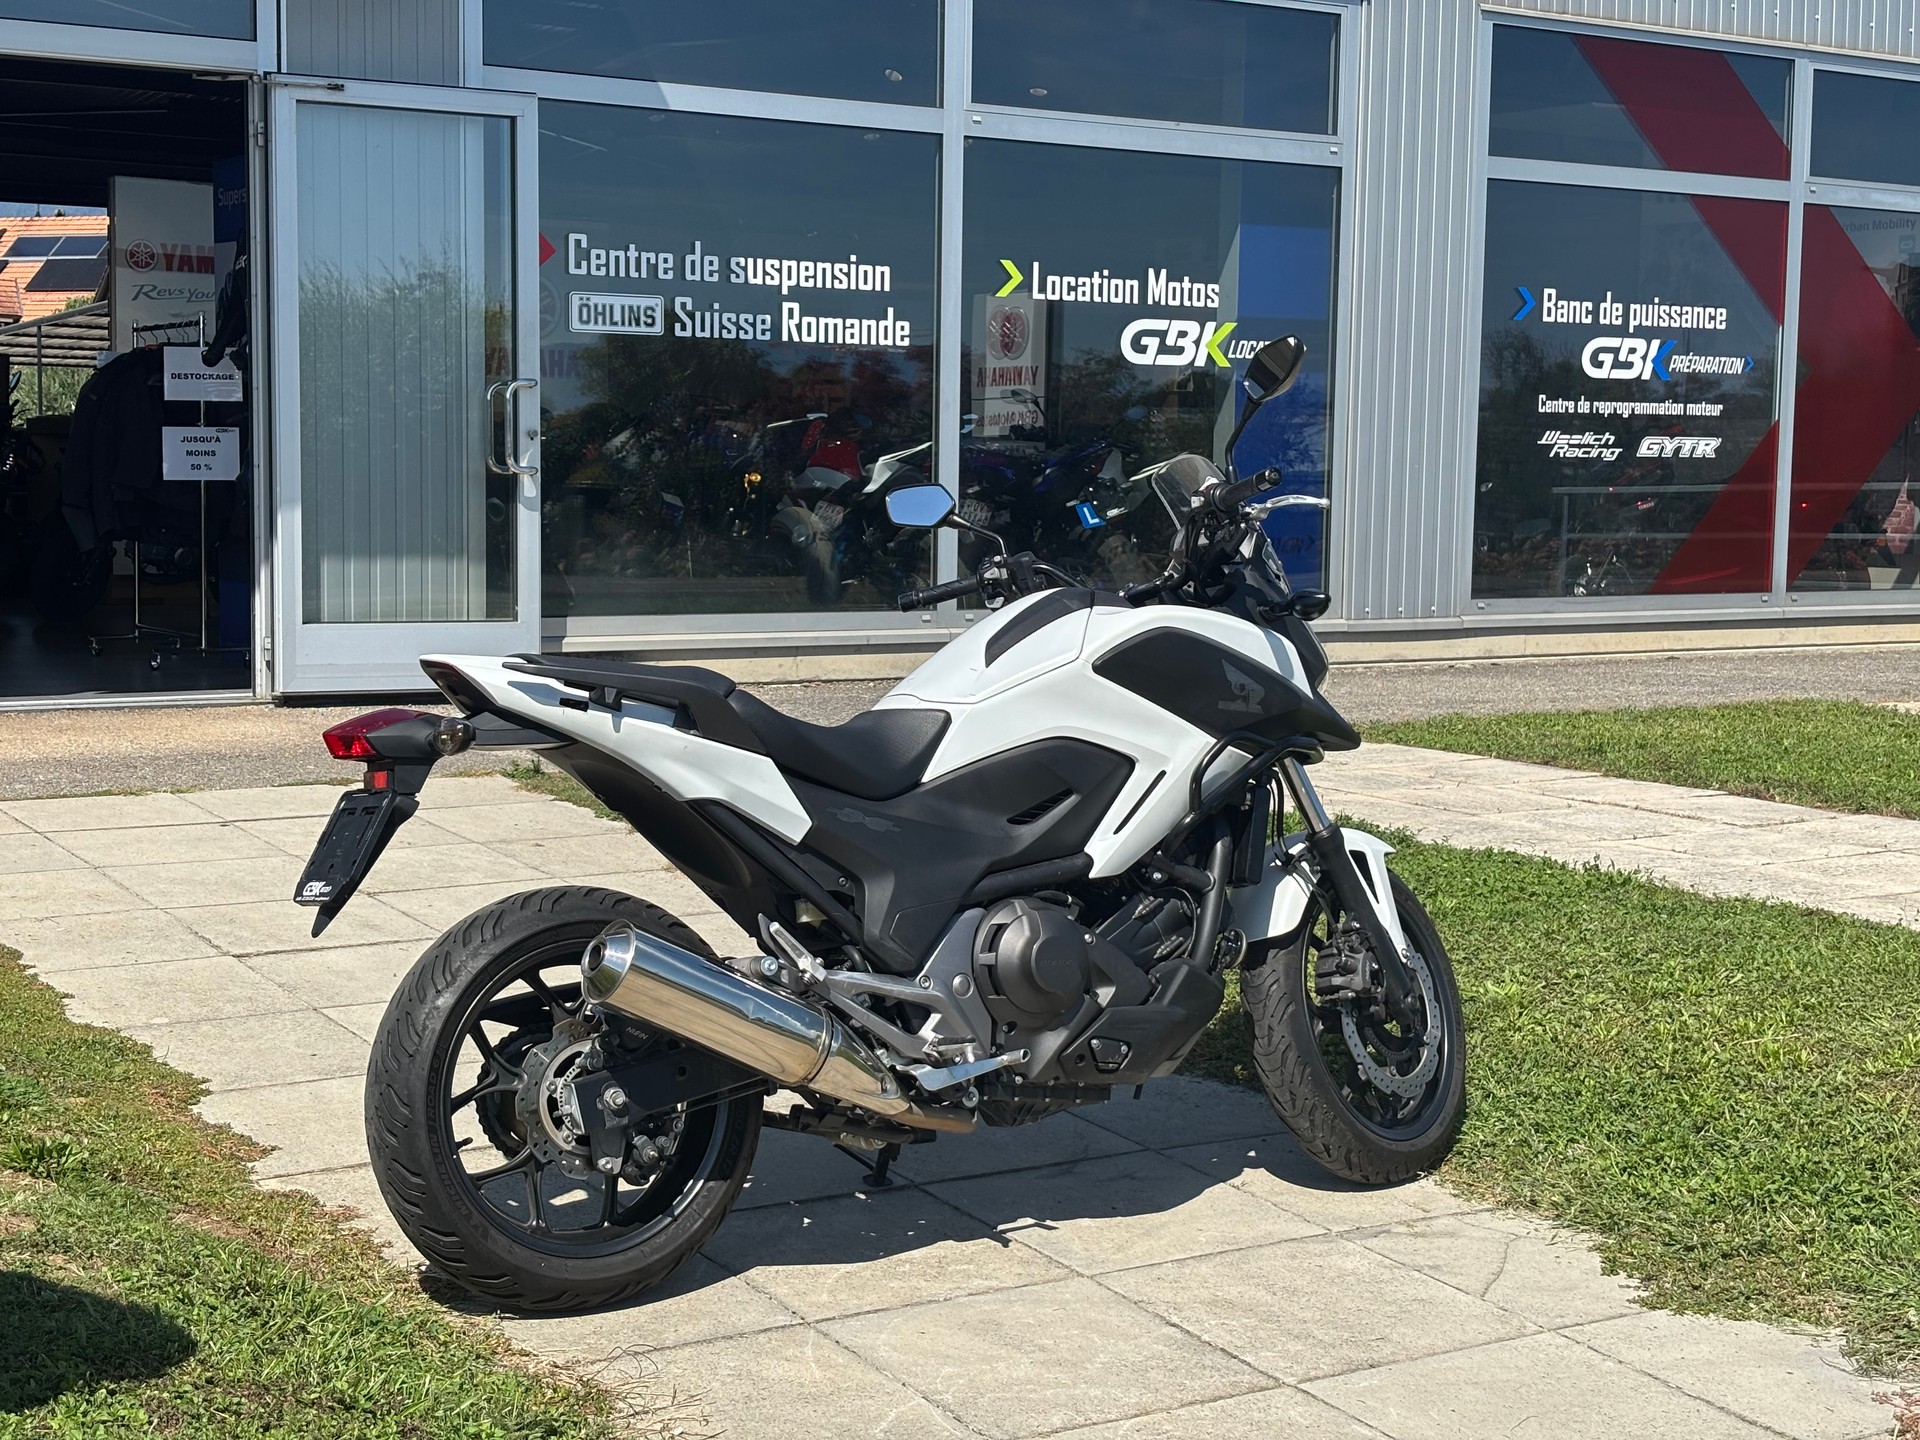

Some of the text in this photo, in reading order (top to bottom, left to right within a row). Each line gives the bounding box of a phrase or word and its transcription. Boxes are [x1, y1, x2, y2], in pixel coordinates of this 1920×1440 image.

[1872, 217, 1916, 231] Mobility
[567, 233, 891, 295] Centre de suspension
[131, 283, 187, 301] Revs
[1032, 261, 1220, 308] Location Motos
[674, 296, 771, 341] Suisse
[781, 301, 911, 347] Romande
[1542, 288, 1728, 333] Banc de puissance
[1120, 318, 1238, 368] GBK
[1581, 337, 1745, 381] GBK PRÉPARATION
[170, 372, 235, 381] DESTOCKAGE
[1538, 394, 1724, 418] Centre de reprogrammation moteur
[180, 435, 222, 443] JUSQU'À
[1636, 436, 1722, 458] GYTR
[1549, 444, 1623, 461] Racing
[190, 463, 213, 471] 50 %
[1083, 507, 1099, 524] L
